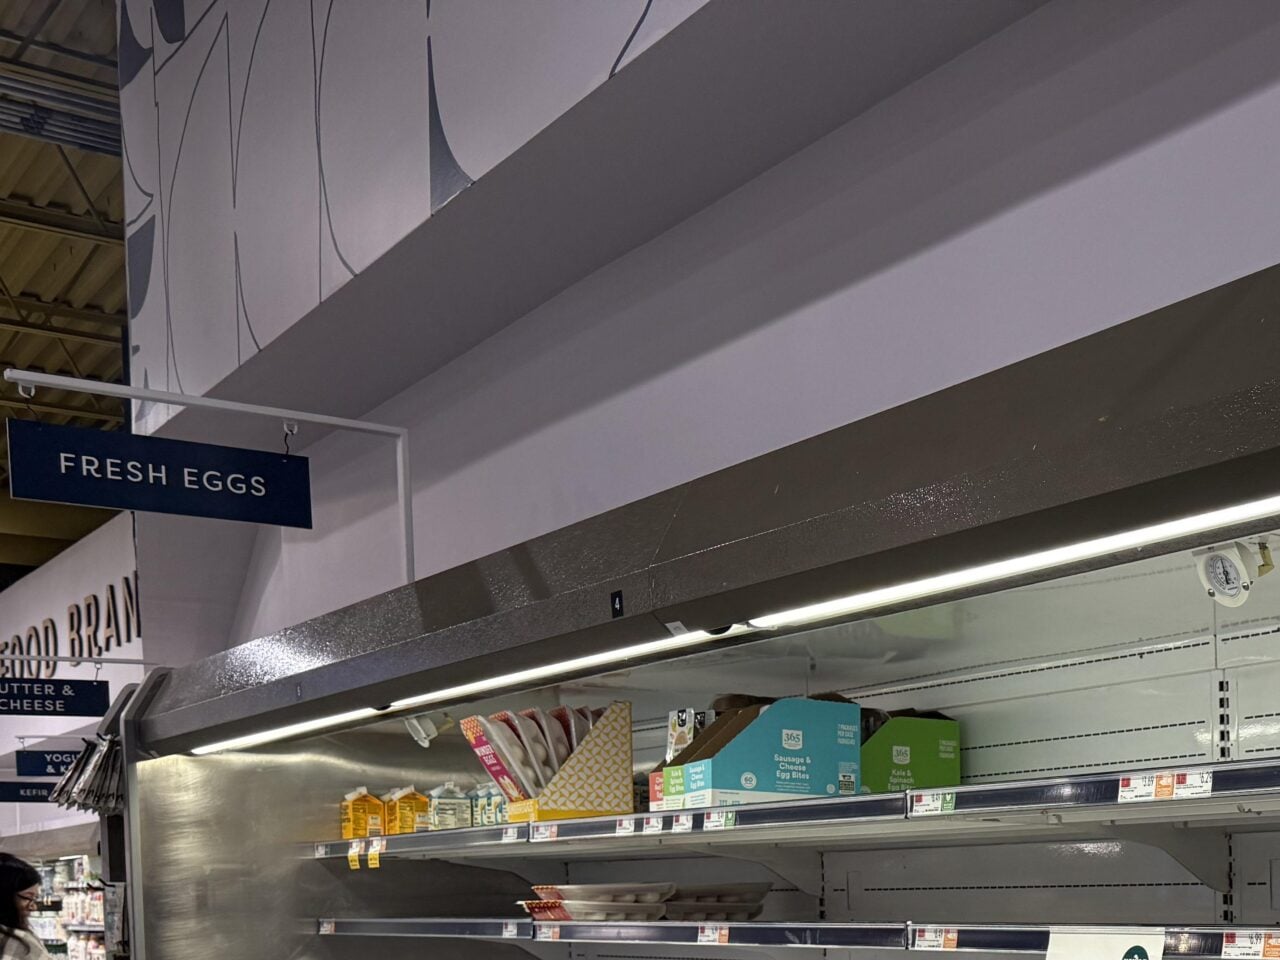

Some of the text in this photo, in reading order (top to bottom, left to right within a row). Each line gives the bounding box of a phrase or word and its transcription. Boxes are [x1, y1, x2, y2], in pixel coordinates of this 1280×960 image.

[59, 452, 266, 497] FRESH EGGS
[614, 597, 621, 611] 4
[62, 684, 75, 696] &
[774, 754, 804, 764] Sausage
[46, 765, 57, 773] &
[779, 763, 806, 771] Cheese
[776, 770, 809, 780] Egg Bites
[20, 788, 48, 796] KEFIR
